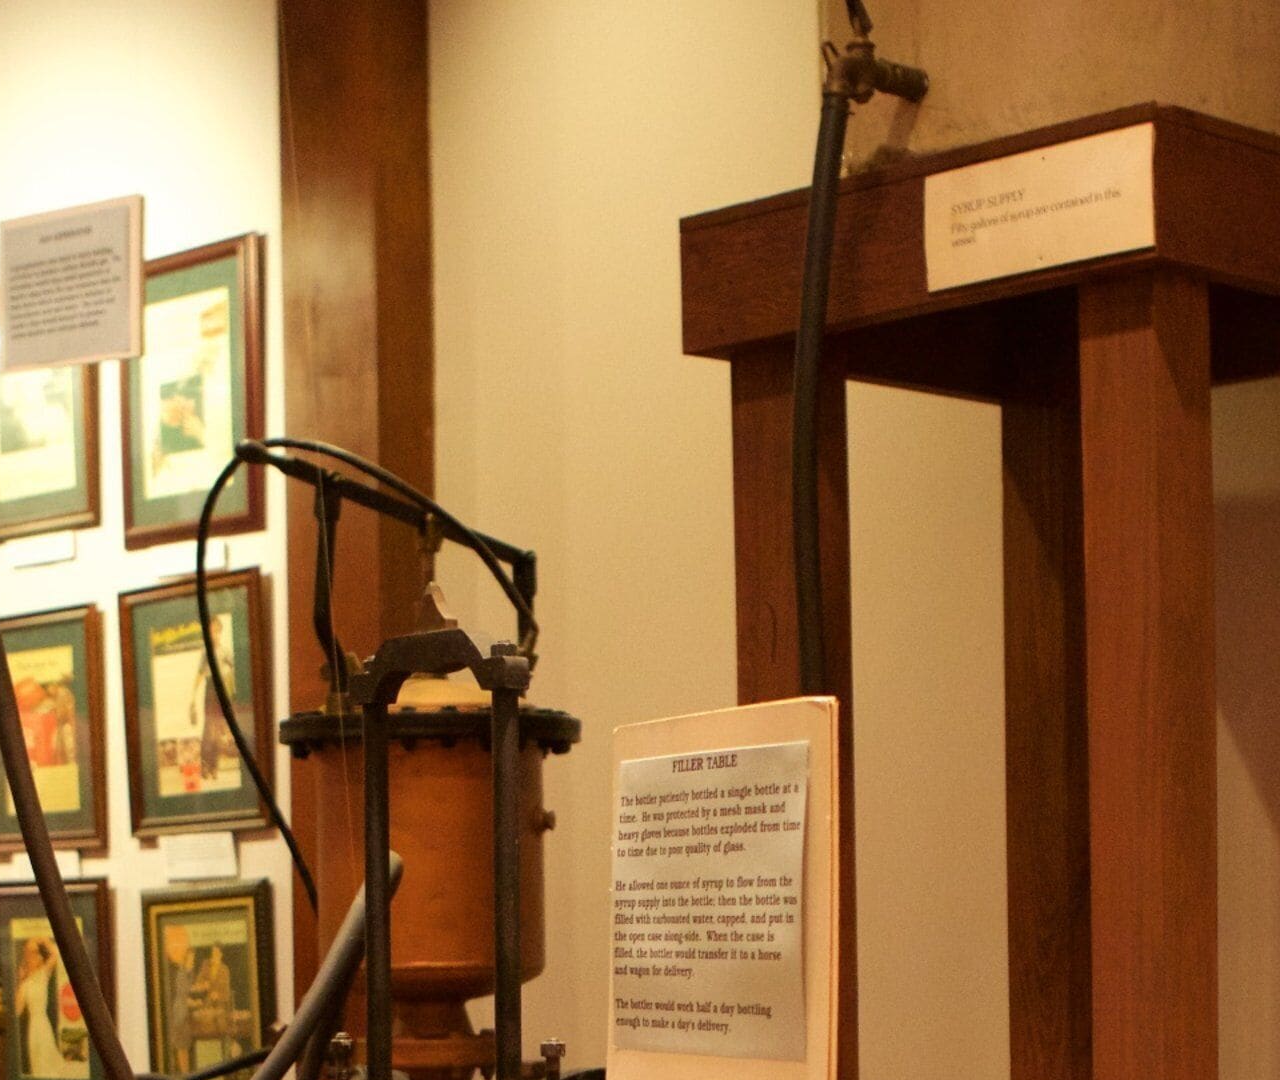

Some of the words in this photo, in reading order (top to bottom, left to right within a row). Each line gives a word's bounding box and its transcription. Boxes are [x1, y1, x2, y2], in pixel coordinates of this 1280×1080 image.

[672, 758, 704, 773] FILLER
[707, 754, 737, 770] TABLE
[621, 797, 633, 806] The
[635, 794, 657, 805] bottler
[658, 792, 689, 806] patiently
[692, 788, 718, 800] bottled
[721, 790, 725, 798] a
[728, 785, 751, 800] single
[754, 783, 780, 796] bottle
[782, 784, 792, 793] at
[620, 813, 637, 823] time.
[642, 811, 651, 822] He
[652, 813, 664, 821] was
[666, 807, 699, 822] protected
[701, 806, 711, 819] by
[720, 804, 741, 815] mesh
[745, 803, 767, 814] mask
[770, 802, 785, 812] and
[618, 830, 639, 841] heavy
[641, 830, 661, 842] gloves
[663, 828, 690, 837] because
[692, 824, 718, 836] bottles
[721, 821, 757, 836] exploded
[760, 822, 780, 832] from
[783, 820, 800, 831] time
[617, 848, 625, 857] to
[628, 847, 643, 857] time
[646, 846, 657, 856] due
[659, 846, 666, 855] to
[668, 846, 683, 858] poor
[685, 842, 710, 857] quality
[713, 841, 722, 851] of
[723, 842, 745, 854] glass.
[615, 881, 626, 891] He
[629, 880, 654, 891] allowed
[656, 882, 668, 890] one
[670, 881, 690, 890] ounce
[692, 877, 700, 889] of
[702, 879, 723, 891] syrup
[726, 878, 734, 888] to
[737, 876, 754, 888] flow
[757, 876, 777, 887] from
[779, 876, 792, 887] the
[615, 899, 636, 910] syrup
[638, 897, 660, 910] supply
[662, 896, 676, 907] into
[678, 895, 689, 906] the
[718, 895, 736, 906] then
[739, 894, 752, 905] the
[755, 894, 780, 905] bottle
[783, 896, 797, 905] was
[614, 914, 633, 924] filled
[636, 914, 651, 924] with
[653, 913, 690, 924] carbonated
[751, 912, 766, 923] and
[769, 912, 783, 926] put
[786, 912, 794, 922] in
[614, 931, 627, 941] the
[629, 933, 645, 943] open
[648, 933, 662, 941] case
[706, 930, 727, 942] When
[730, 930, 744, 942] the
[747, 933, 765, 941] case
[767, 931, 774, 942] is
[637, 947, 647, 958] the
[649, 948, 673, 958] bottler
[675, 948, 695, 959] would
[698, 948, 728, 960] transfer
[731, 949, 737, 960] it
[740, 950, 748, 960] to
[751, 952, 755, 960] a
[758, 949, 782, 961] horse
[614, 965, 628, 975] and
[629, 967, 650, 978] wagon
[652, 965, 662, 976] for
[664, 966, 694, 979] delivery.
[616, 998, 629, 1009] The
[630, 999, 652, 1010] bottler
[655, 1000, 675, 1011] would
[677, 1002, 694, 1012] work
[696, 1002, 711, 1013] half
[713, 1005, 718, 1013] a
[720, 1003, 734, 1017] day
[737, 1002, 772, 1019] bottling
[616, 1018, 640, 1029] enough
[642, 1018, 649, 1027] to
[651, 1018, 669, 1028] make
[677, 1019, 695, 1032] day's
[697, 1019, 731, 1035] delivery.
